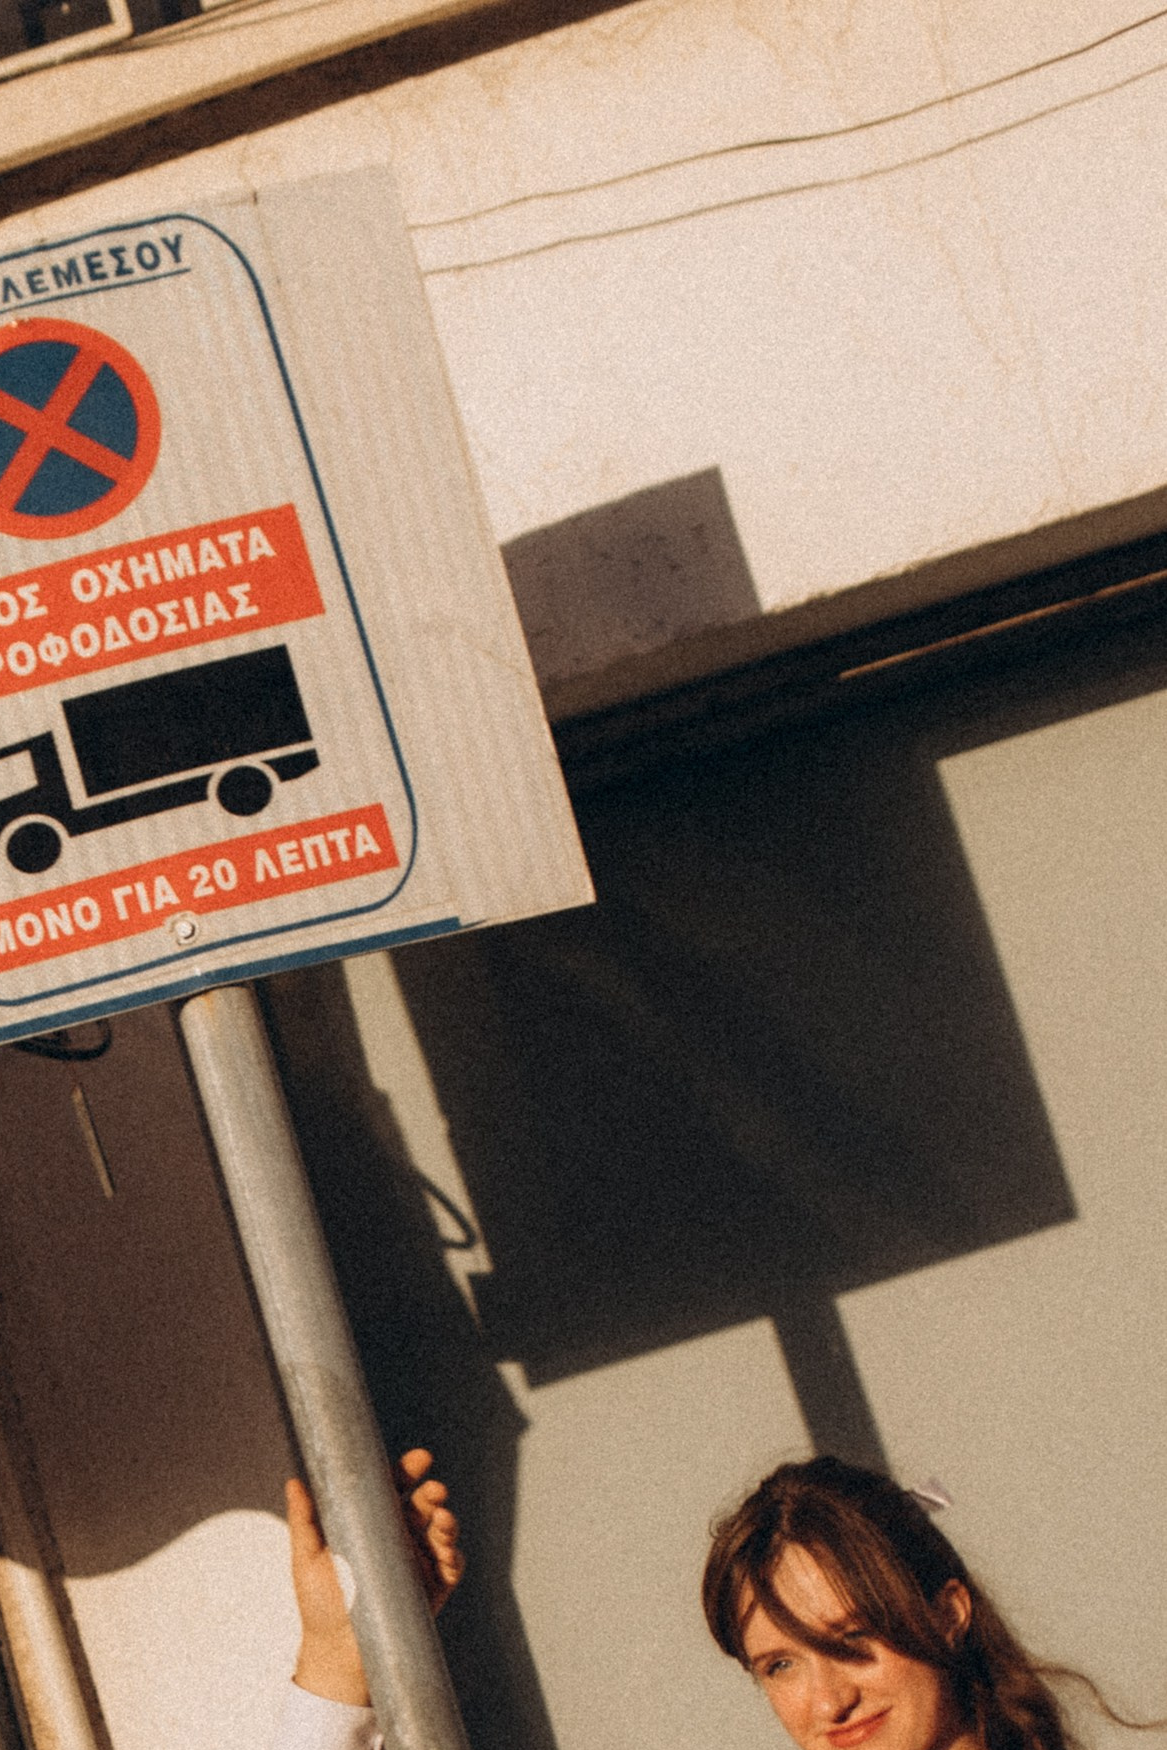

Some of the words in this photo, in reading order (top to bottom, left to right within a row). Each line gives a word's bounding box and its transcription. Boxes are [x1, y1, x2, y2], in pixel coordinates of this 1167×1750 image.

[1, 233, 185, 303] ΛΕΜΕΣΟΥ
[70, 526, 276, 604] ΟΧΗΜΑΤΑ
[111, 875, 181, 921] ΓΙΑ
[188, 858, 238, 899] 20
[255, 824, 382, 882] ΛΕΠΤΑ
